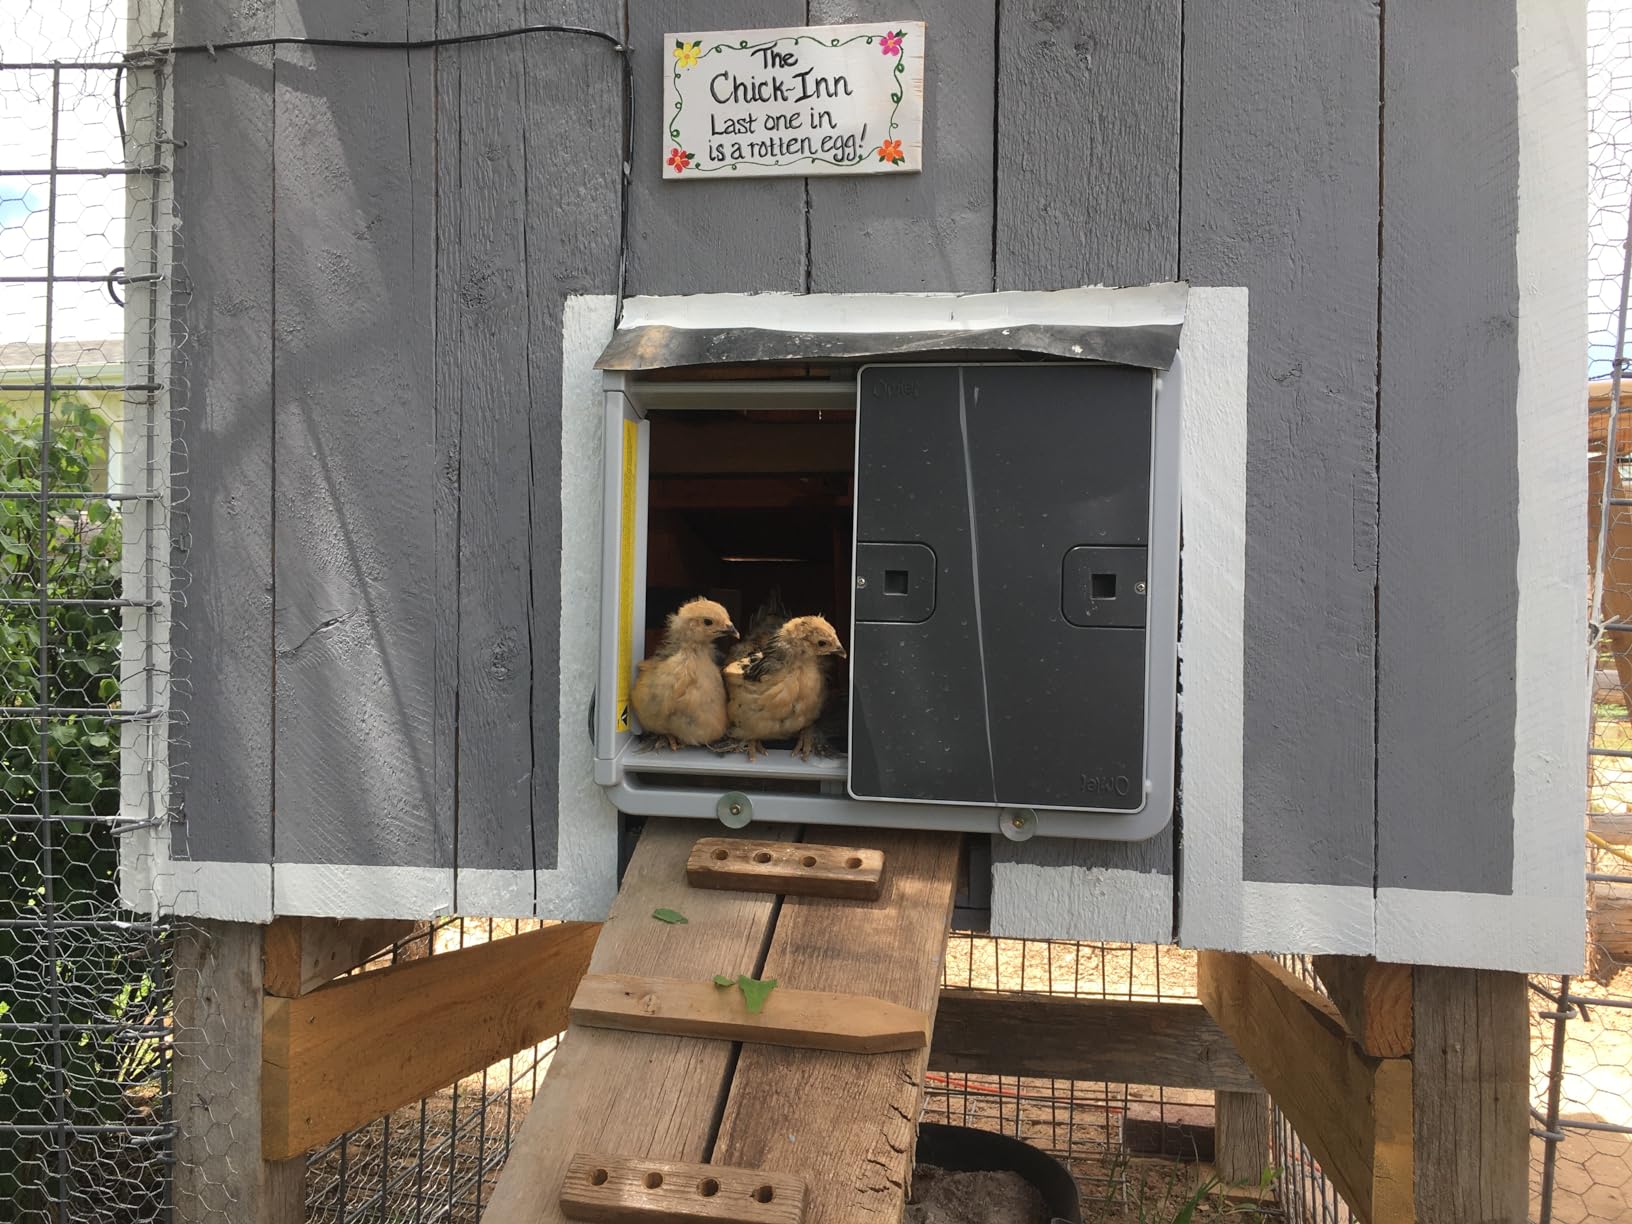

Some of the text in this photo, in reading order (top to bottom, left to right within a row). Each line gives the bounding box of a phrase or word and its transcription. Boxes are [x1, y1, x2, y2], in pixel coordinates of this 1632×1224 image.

[750, 41, 799, 70] The
[710, 107, 838, 136] Last one in
[708, 122, 868, 162] is a rotten egg!
